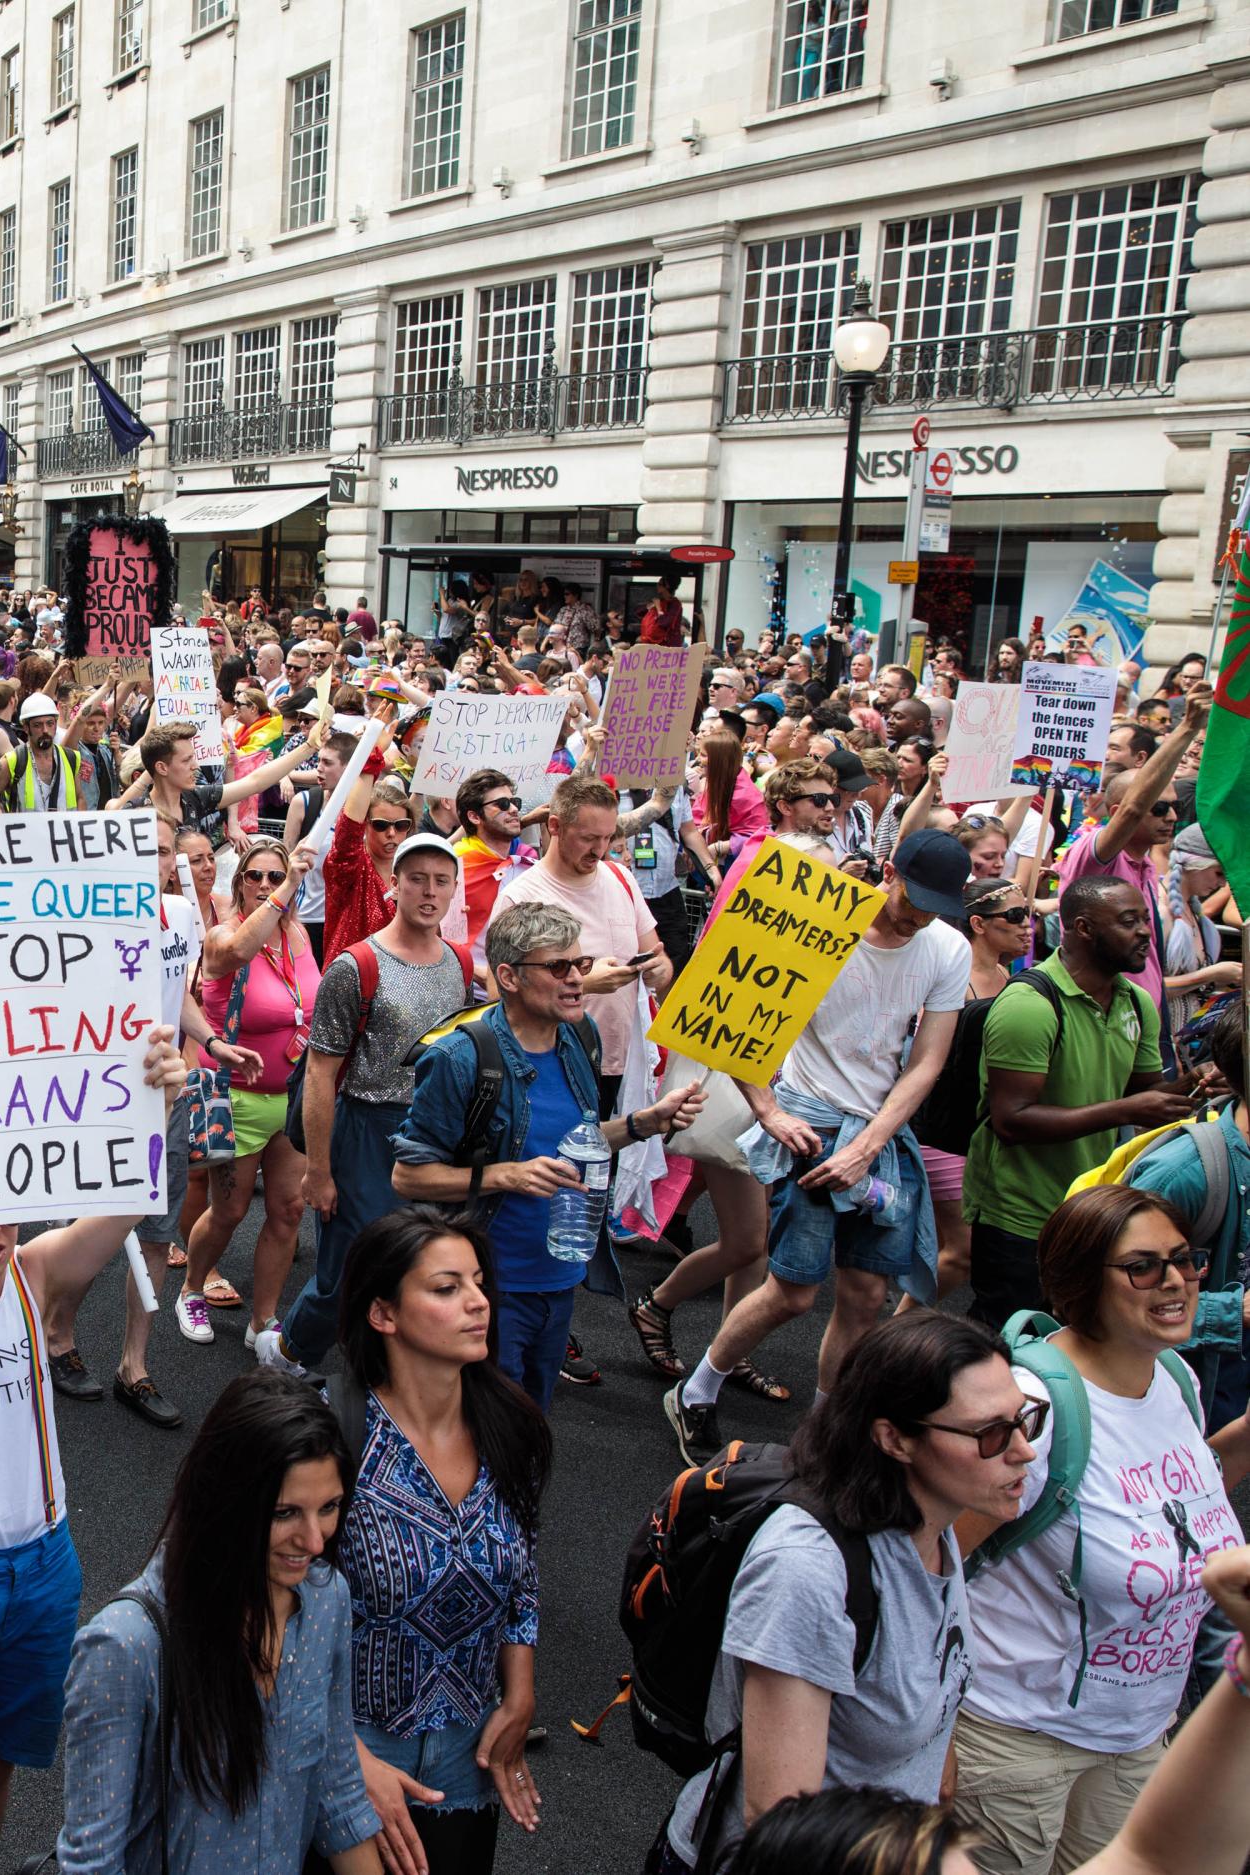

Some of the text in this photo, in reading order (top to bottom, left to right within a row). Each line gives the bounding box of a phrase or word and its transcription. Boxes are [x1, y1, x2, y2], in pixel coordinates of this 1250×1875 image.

[70, 480, 114, 495] CAFE ROYAL
[231, 465, 271, 485] Wolford
[454, 465, 559, 496] NESPRESSO
[88, 556, 151, 584] JUST
[619, 650, 689, 672] NO PRIDE
[614, 674, 687, 693] TIL WE'RE
[1025, 678, 1078, 688] MOVEMENT
[436, 698, 566, 727] STOP DEPORTING
[609, 695, 636, 714] ALL
[1035, 694, 1096, 712] Tear down
[607, 713, 672, 736] RELEASE
[1031, 711, 1095, 729] the fences
[603, 735, 659, 757] EVERY
[1034, 726, 1089, 743] OPEN THE
[1031, 743, 1087, 760] BORDERS
[48, 816, 158, 863] HERE
[752, 849, 874, 921] ARMY
[32, 878, 157, 922] QUEER
[724, 887, 862, 961] DREAMERS?
[717, 945, 810, 1000] NOT
[699, 981, 793, 1037] IN MY
[670, 1004, 776, 1065] NAME!
[1114, 1443, 1206, 1505] NOT GAY
[1130, 1503, 1234, 1551] AS IN HAPPY
[1164, 1592, 1200, 1619] AS IN
[1104, 1618, 1178, 1646] FUCK
[1083, 1671, 1120, 1686] ESBIANS
